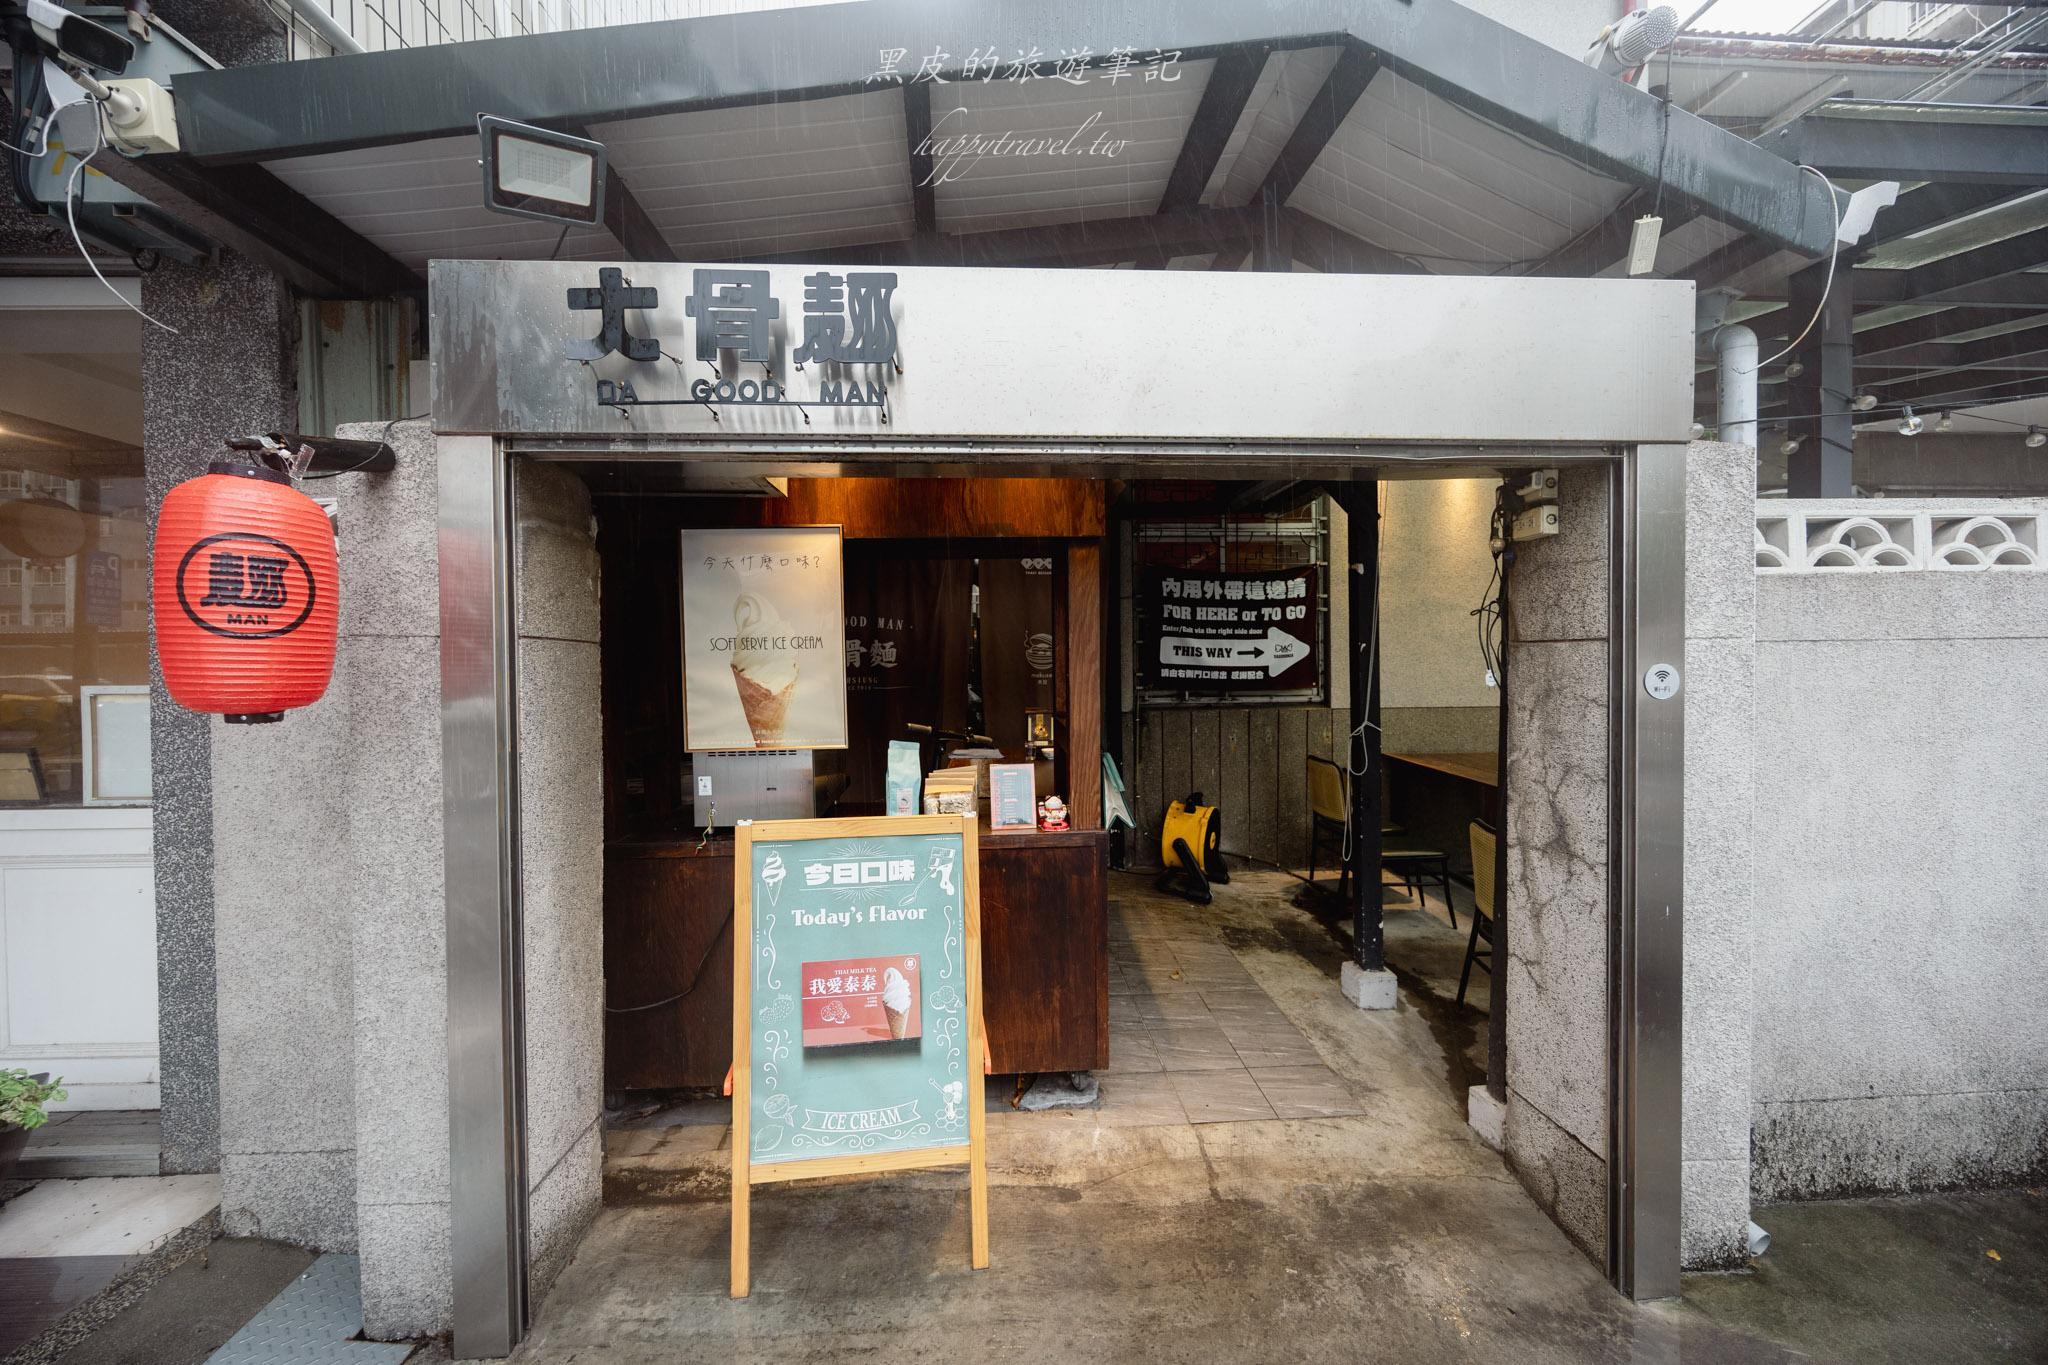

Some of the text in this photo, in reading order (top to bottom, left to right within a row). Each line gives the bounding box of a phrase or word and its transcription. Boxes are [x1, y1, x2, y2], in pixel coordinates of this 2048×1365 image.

[597, 378, 885, 404] DA GOOD MAN
[703, 555, 820, 571] 今天什麼口味?
[1162, 577, 1306, 601] 內用外帶這邊請
[227, 613, 269, 625] MAN
[1163, 604, 1307, 622] FOR HERE or TO GO
[878, 616, 905, 632] MAN
[1206, 627, 1217, 635] the
[1218, 627, 1233, 637] right
[1249, 627, 1263, 636] door
[710, 635, 824, 652] SOFT SERVE ICE CREAM
[1173, 645, 1233, 659] THIS WAY
[803, 859, 916, 886] 今日口味
[791, 906, 863, 928] Today's
[834, 968, 850, 976] THAI
[866, 966, 877, 974] TEA
[808, 974, 877, 995] 我愛泰泰
[821, 1107, 903, 1131] ICE CREAM
